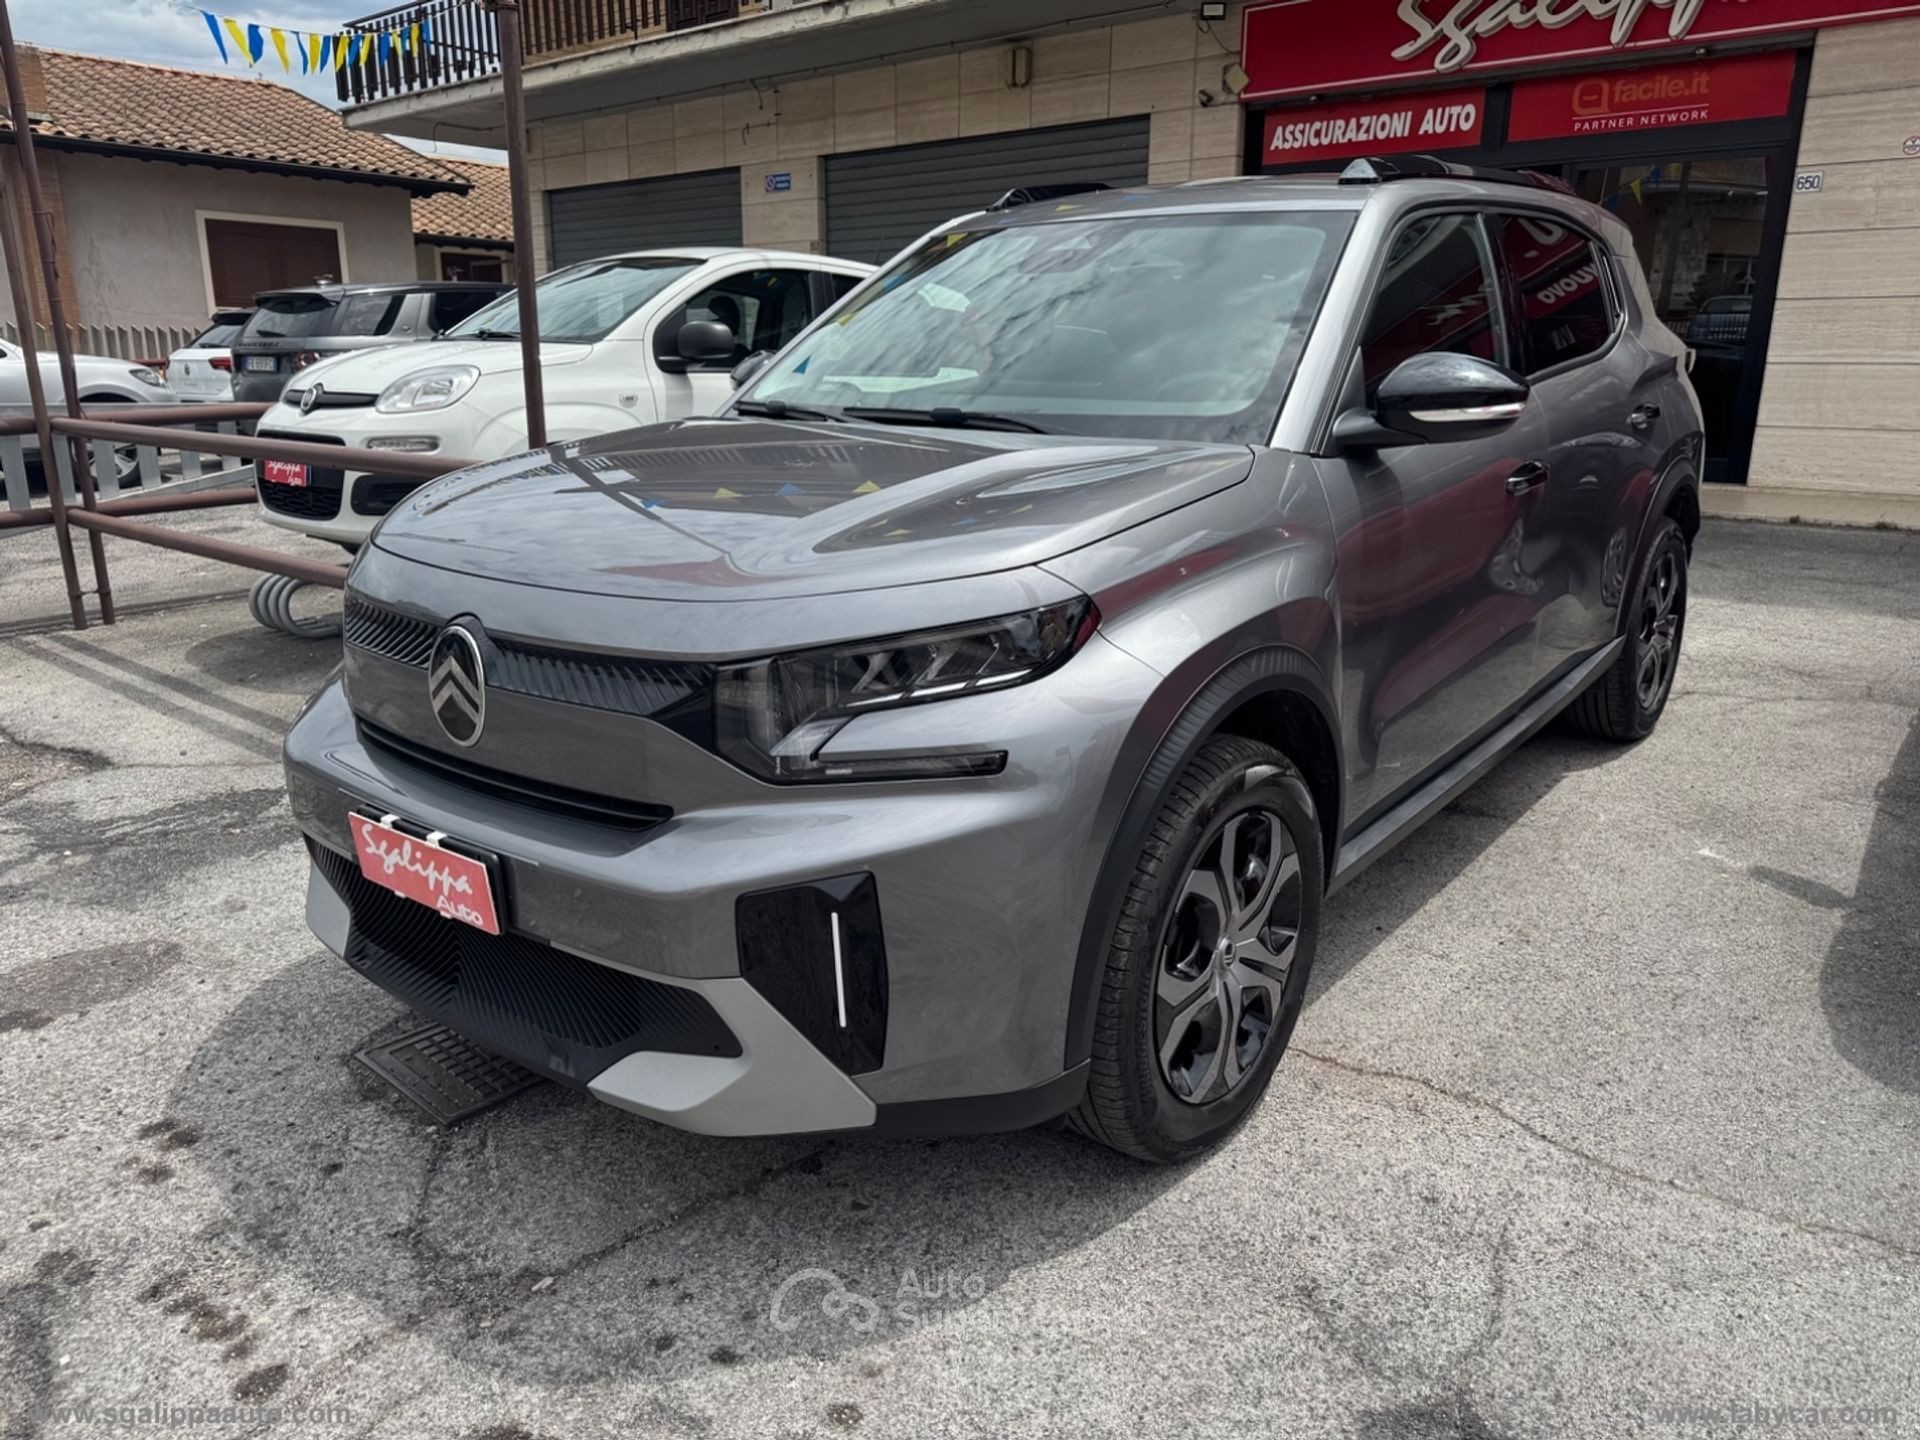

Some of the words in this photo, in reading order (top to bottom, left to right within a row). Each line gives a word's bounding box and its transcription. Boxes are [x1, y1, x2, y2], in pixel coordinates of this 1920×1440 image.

[1613, 71, 1711, 103] facile.it
[1270, 111, 1413, 150] ASSICURAZIONI
[1418, 103, 1476, 136] AUTO
[1574, 116, 1635, 132] PARTNER
[1640, 109, 1709, 125] NETWORK
[1795, 174, 1821, 191] 650
[361, 823, 474, 897] Sgalippa
